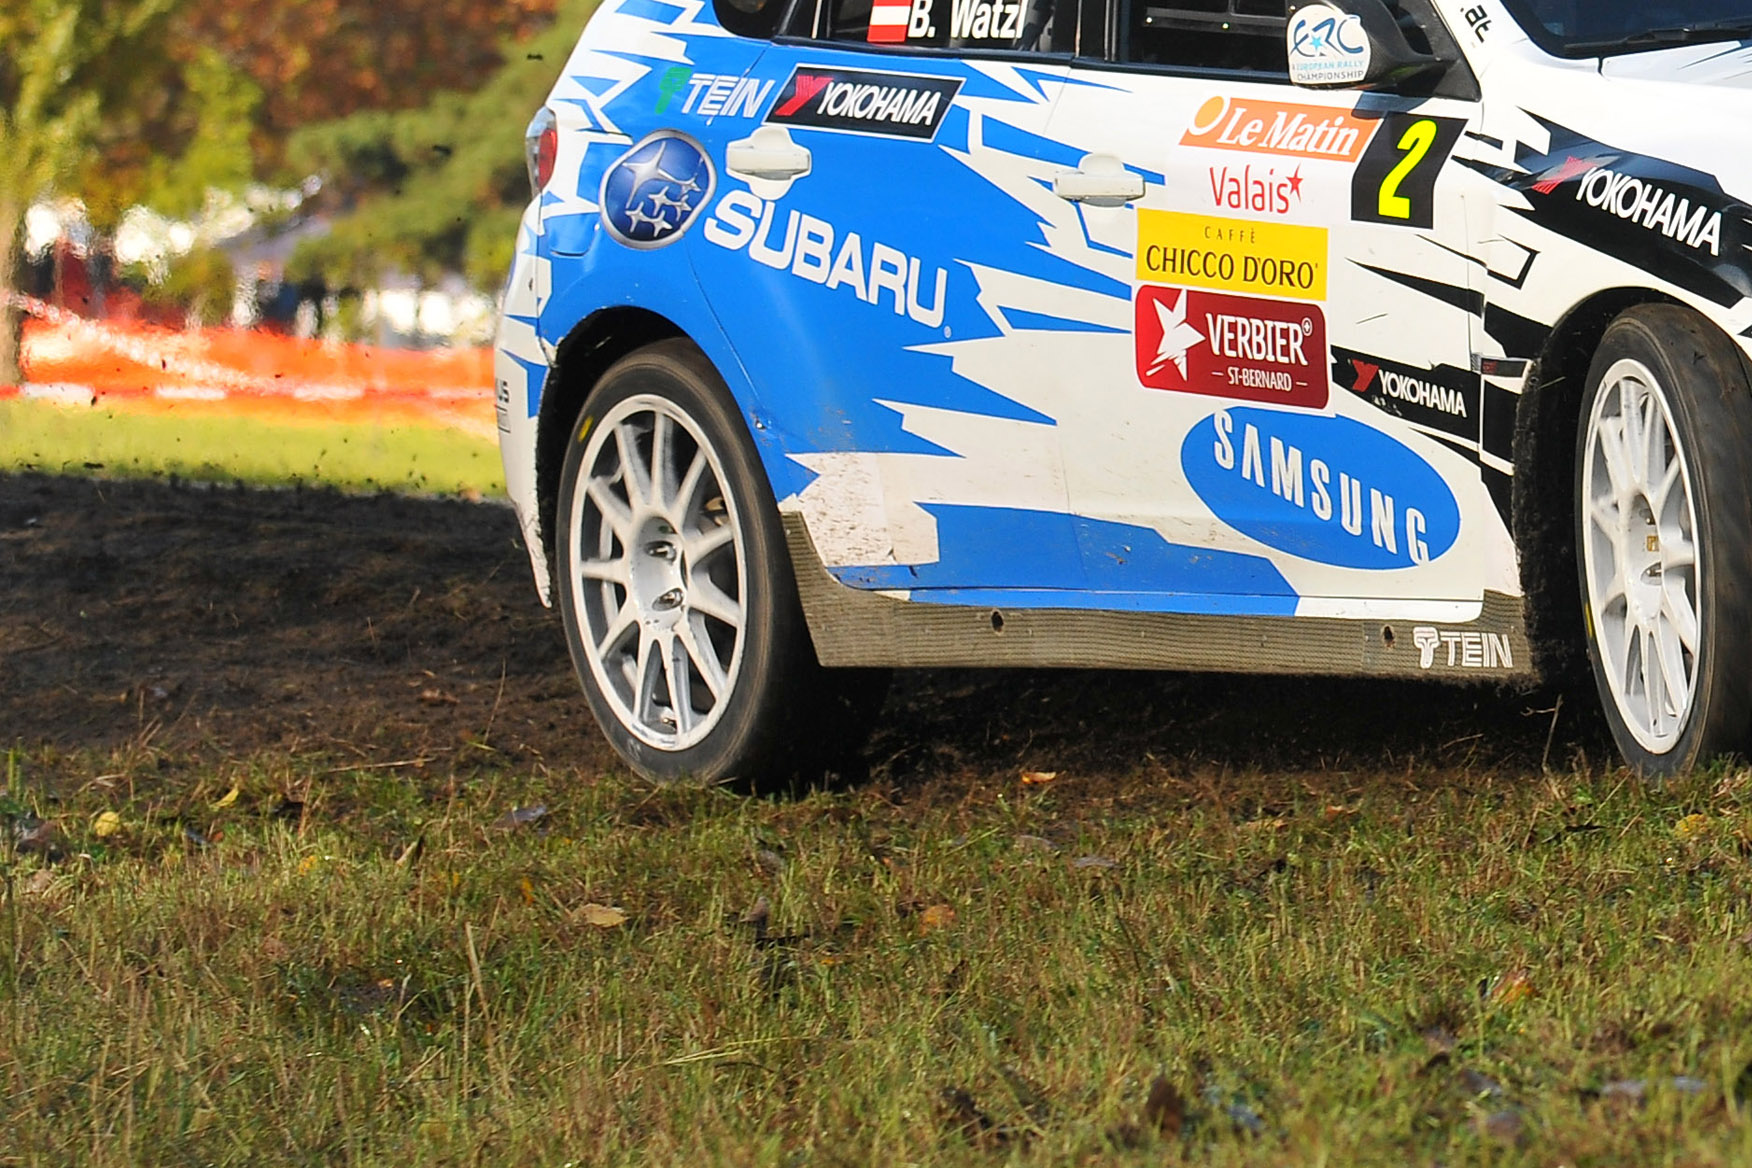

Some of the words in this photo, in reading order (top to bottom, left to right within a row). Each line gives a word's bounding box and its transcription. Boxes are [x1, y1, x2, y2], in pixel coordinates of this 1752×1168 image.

[681, 73, 776, 118] TEIN
[1297, 71, 1364, 81] CHAMPIONSHIP
[817, 82, 942, 126] YOKOHAMA
[1216, 106, 1256, 146] Le
[1259, 110, 1360, 156] Matin
[1209, 164, 1291, 214] Valais
[1378, 119, 1438, 219] 2
[1204, 224, 1256, 244] CAFFÈ
[1576, 166, 1724, 256] YOKOHAMA
[704, 189, 948, 328] SUBARU
[1146, 244, 1235, 280] CHICCO
[1205, 312, 1309, 365] VERBIER
[1228, 367, 1293, 393] ST-BERNARD
[1377, 369, 1467, 418] YOKOHAMA
[1213, 408, 1430, 566] SAMSUNG
[1440, 631, 1513, 668] TEIN
